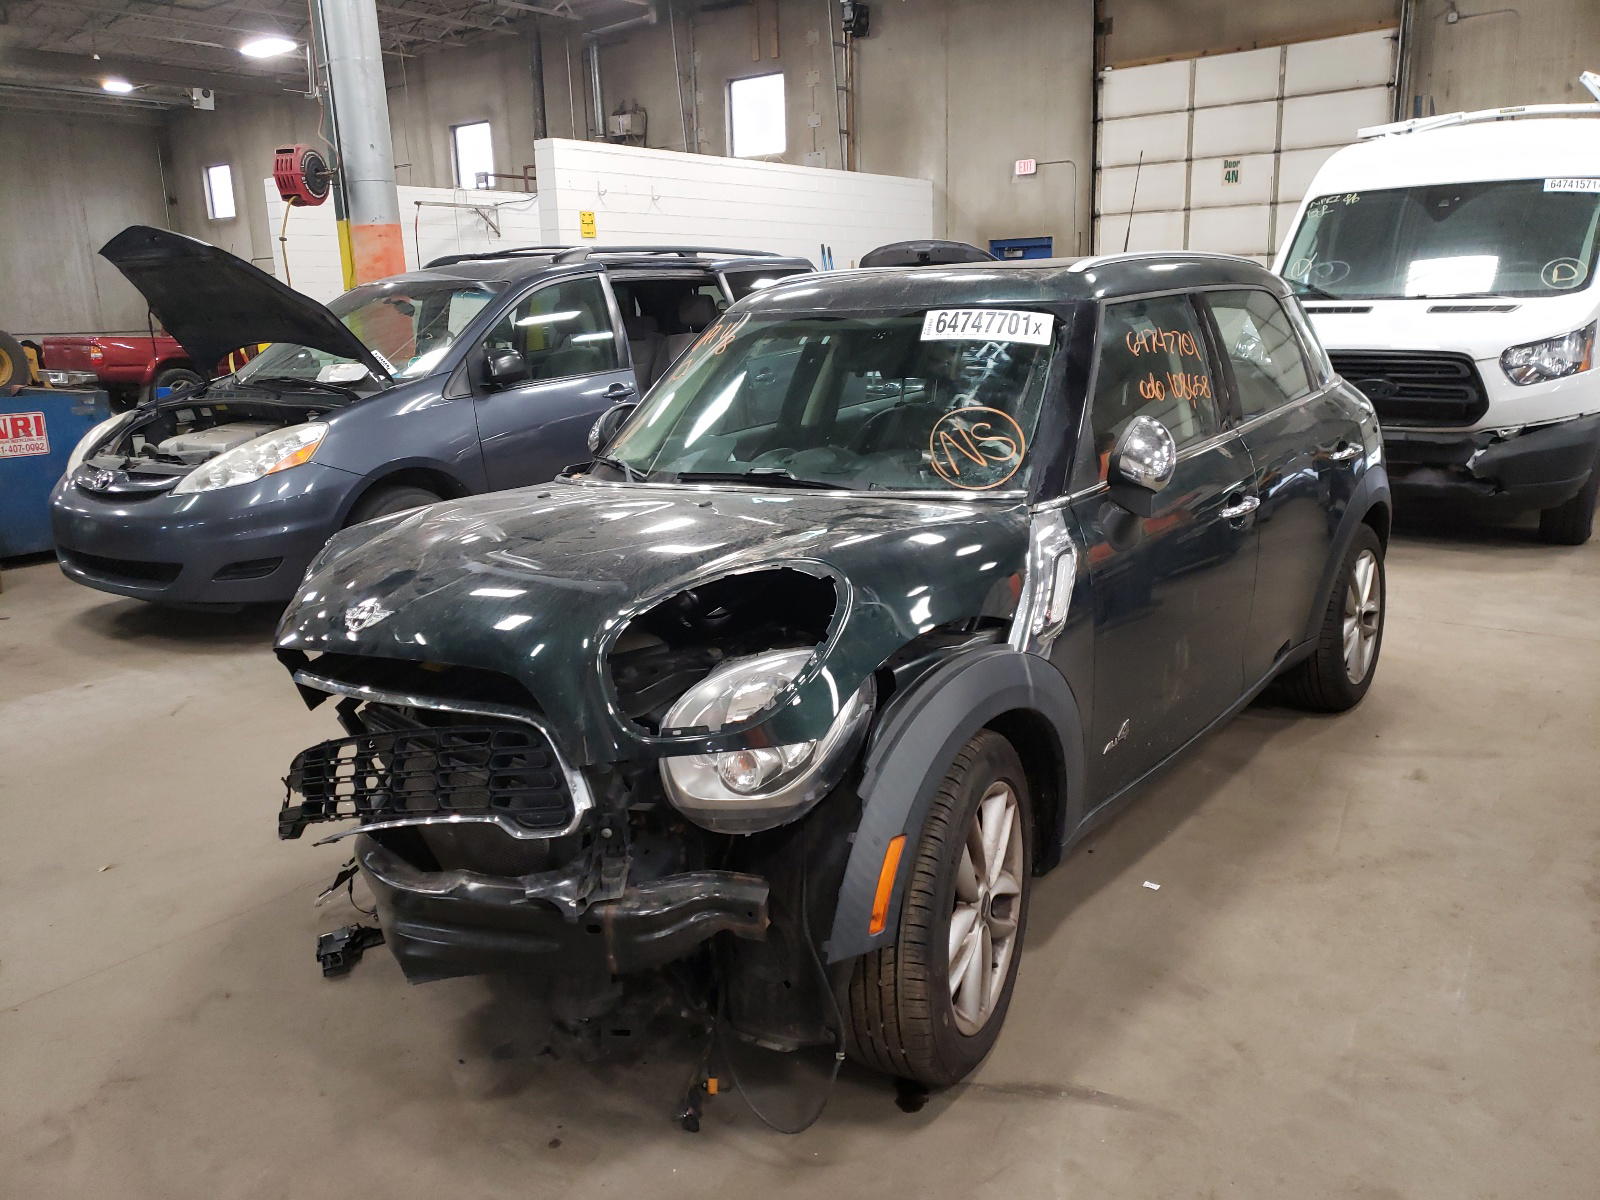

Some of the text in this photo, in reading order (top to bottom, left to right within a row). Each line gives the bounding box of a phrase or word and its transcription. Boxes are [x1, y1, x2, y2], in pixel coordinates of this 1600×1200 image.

[1018, 160, 1033, 173] EXIT
[1224, 160, 1241, 169] Door
[1225, 170, 1239, 184] 4N
[1125, 327, 1202, 361] 64747701
